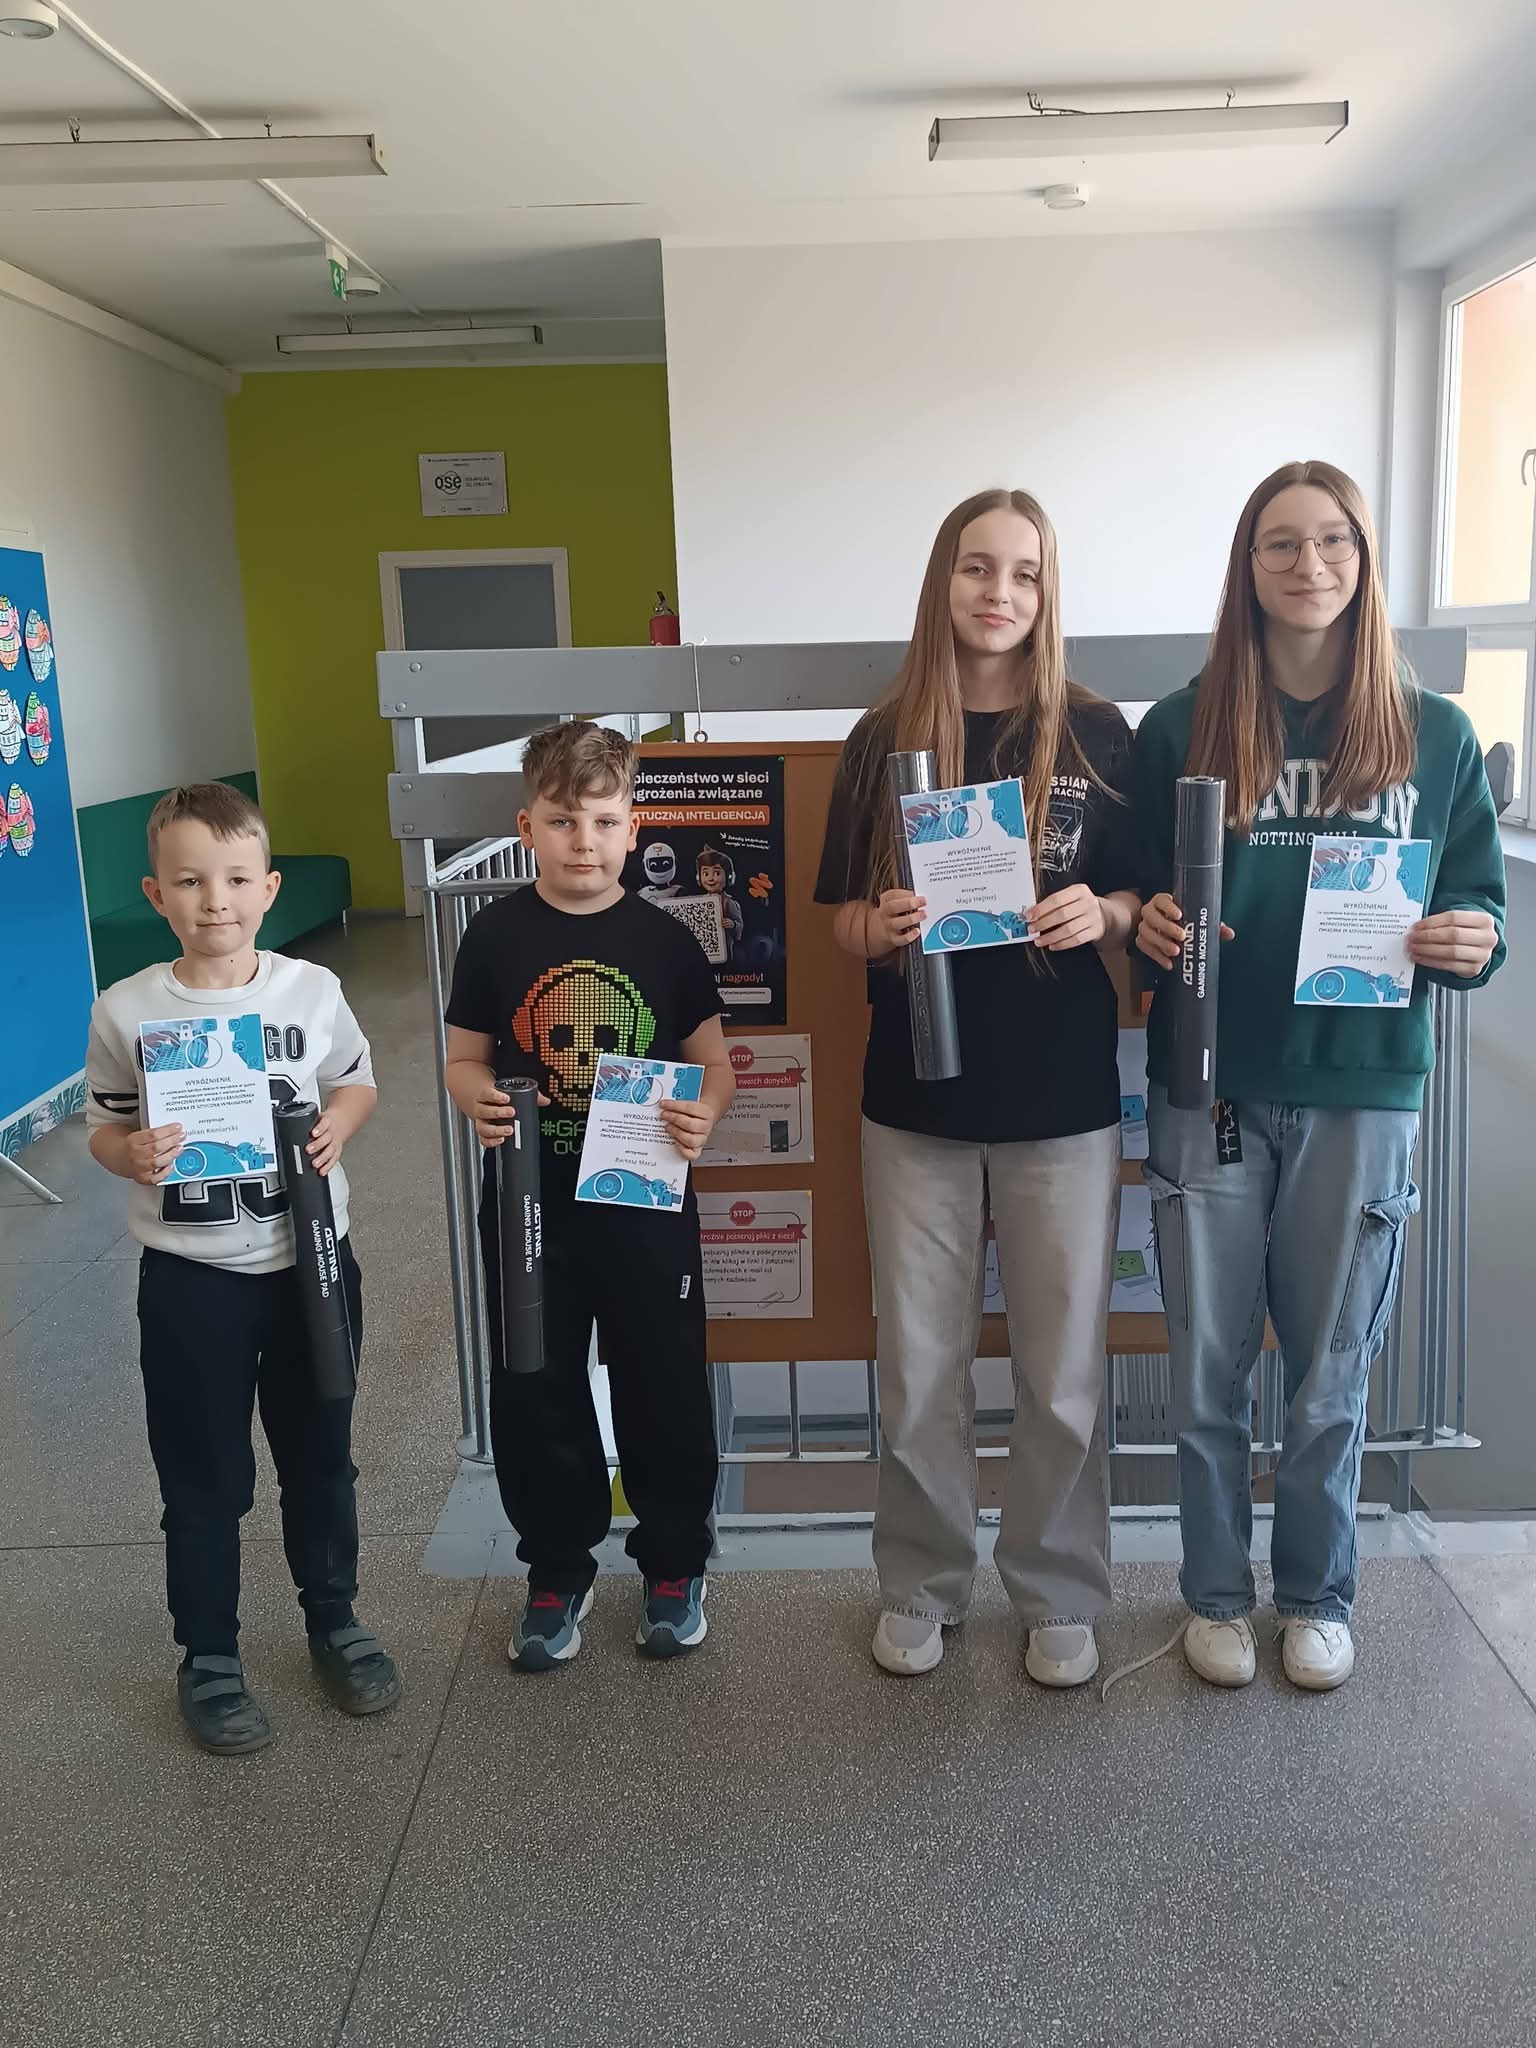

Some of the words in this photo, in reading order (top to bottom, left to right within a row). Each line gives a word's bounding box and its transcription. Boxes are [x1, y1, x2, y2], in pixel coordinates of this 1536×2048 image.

[435, 476, 461, 489] ose
[722, 774, 734, 784] w
[737, 772, 769, 783] sieci
[698, 787, 763, 801] związane
[1054, 787, 1086, 800] RACING
[686, 811, 765, 823] INTELIGENCJĄ
[1200, 907, 1208, 927] PAD
[1199, 928, 1207, 960] MOUSE
[1197, 961, 1206, 998] GAMING
[731, 1054, 752, 1063] STOP
[524, 1194, 532, 1227] GAMING
[733, 1209, 754, 1218] STOP
[311, 1219, 323, 1252] GAMING
[316, 1253, 327, 1281] MOUSE
[320, 1282, 329, 1298] PAD
